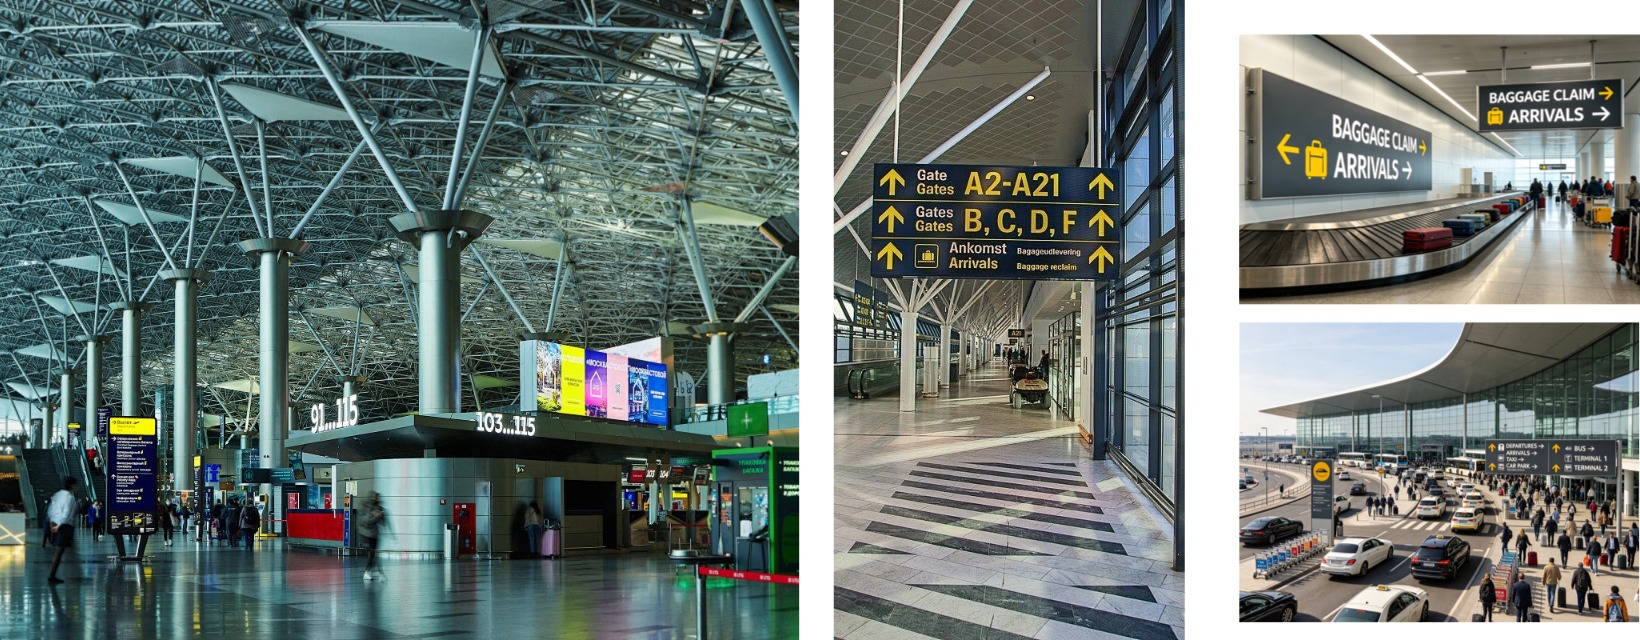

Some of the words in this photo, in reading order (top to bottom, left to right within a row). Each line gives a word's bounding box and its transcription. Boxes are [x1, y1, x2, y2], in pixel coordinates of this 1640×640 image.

[1489, 89, 1550, 104] BAGGAGE
[1553, 87, 1595, 101] CLAIM
[1508, 107, 1584, 123] ARRIVALS
[1332, 113, 1390, 148] BAGGAGE
[1392, 131, 1417, 154] CLAIM
[1333, 151, 1399, 180] ARRIVALS
[917, 169, 947, 181] Gate
[916, 183, 954, 195] Gates
[964, 171, 1060, 197] A2-A21
[915, 206, 954, 218] Gates
[915, 220, 953, 232] Gates
[964, 208, 989, 236] B,
[997, 208, 1022, 236] C,
[1030, 209, 1055, 237] D,
[1063, 210, 1077, 234] F
[949, 242, 1007, 254] Ankomst
[1017, 247, 1081, 257] Bagageudlevering
[949, 257, 998, 270] Arrivals
[1016, 263, 1048, 271] Baggage
[1050, 263, 1077, 271] reclaim
[310, 395, 359, 434] 91...115
[475, 411, 536, 437] 103...115
